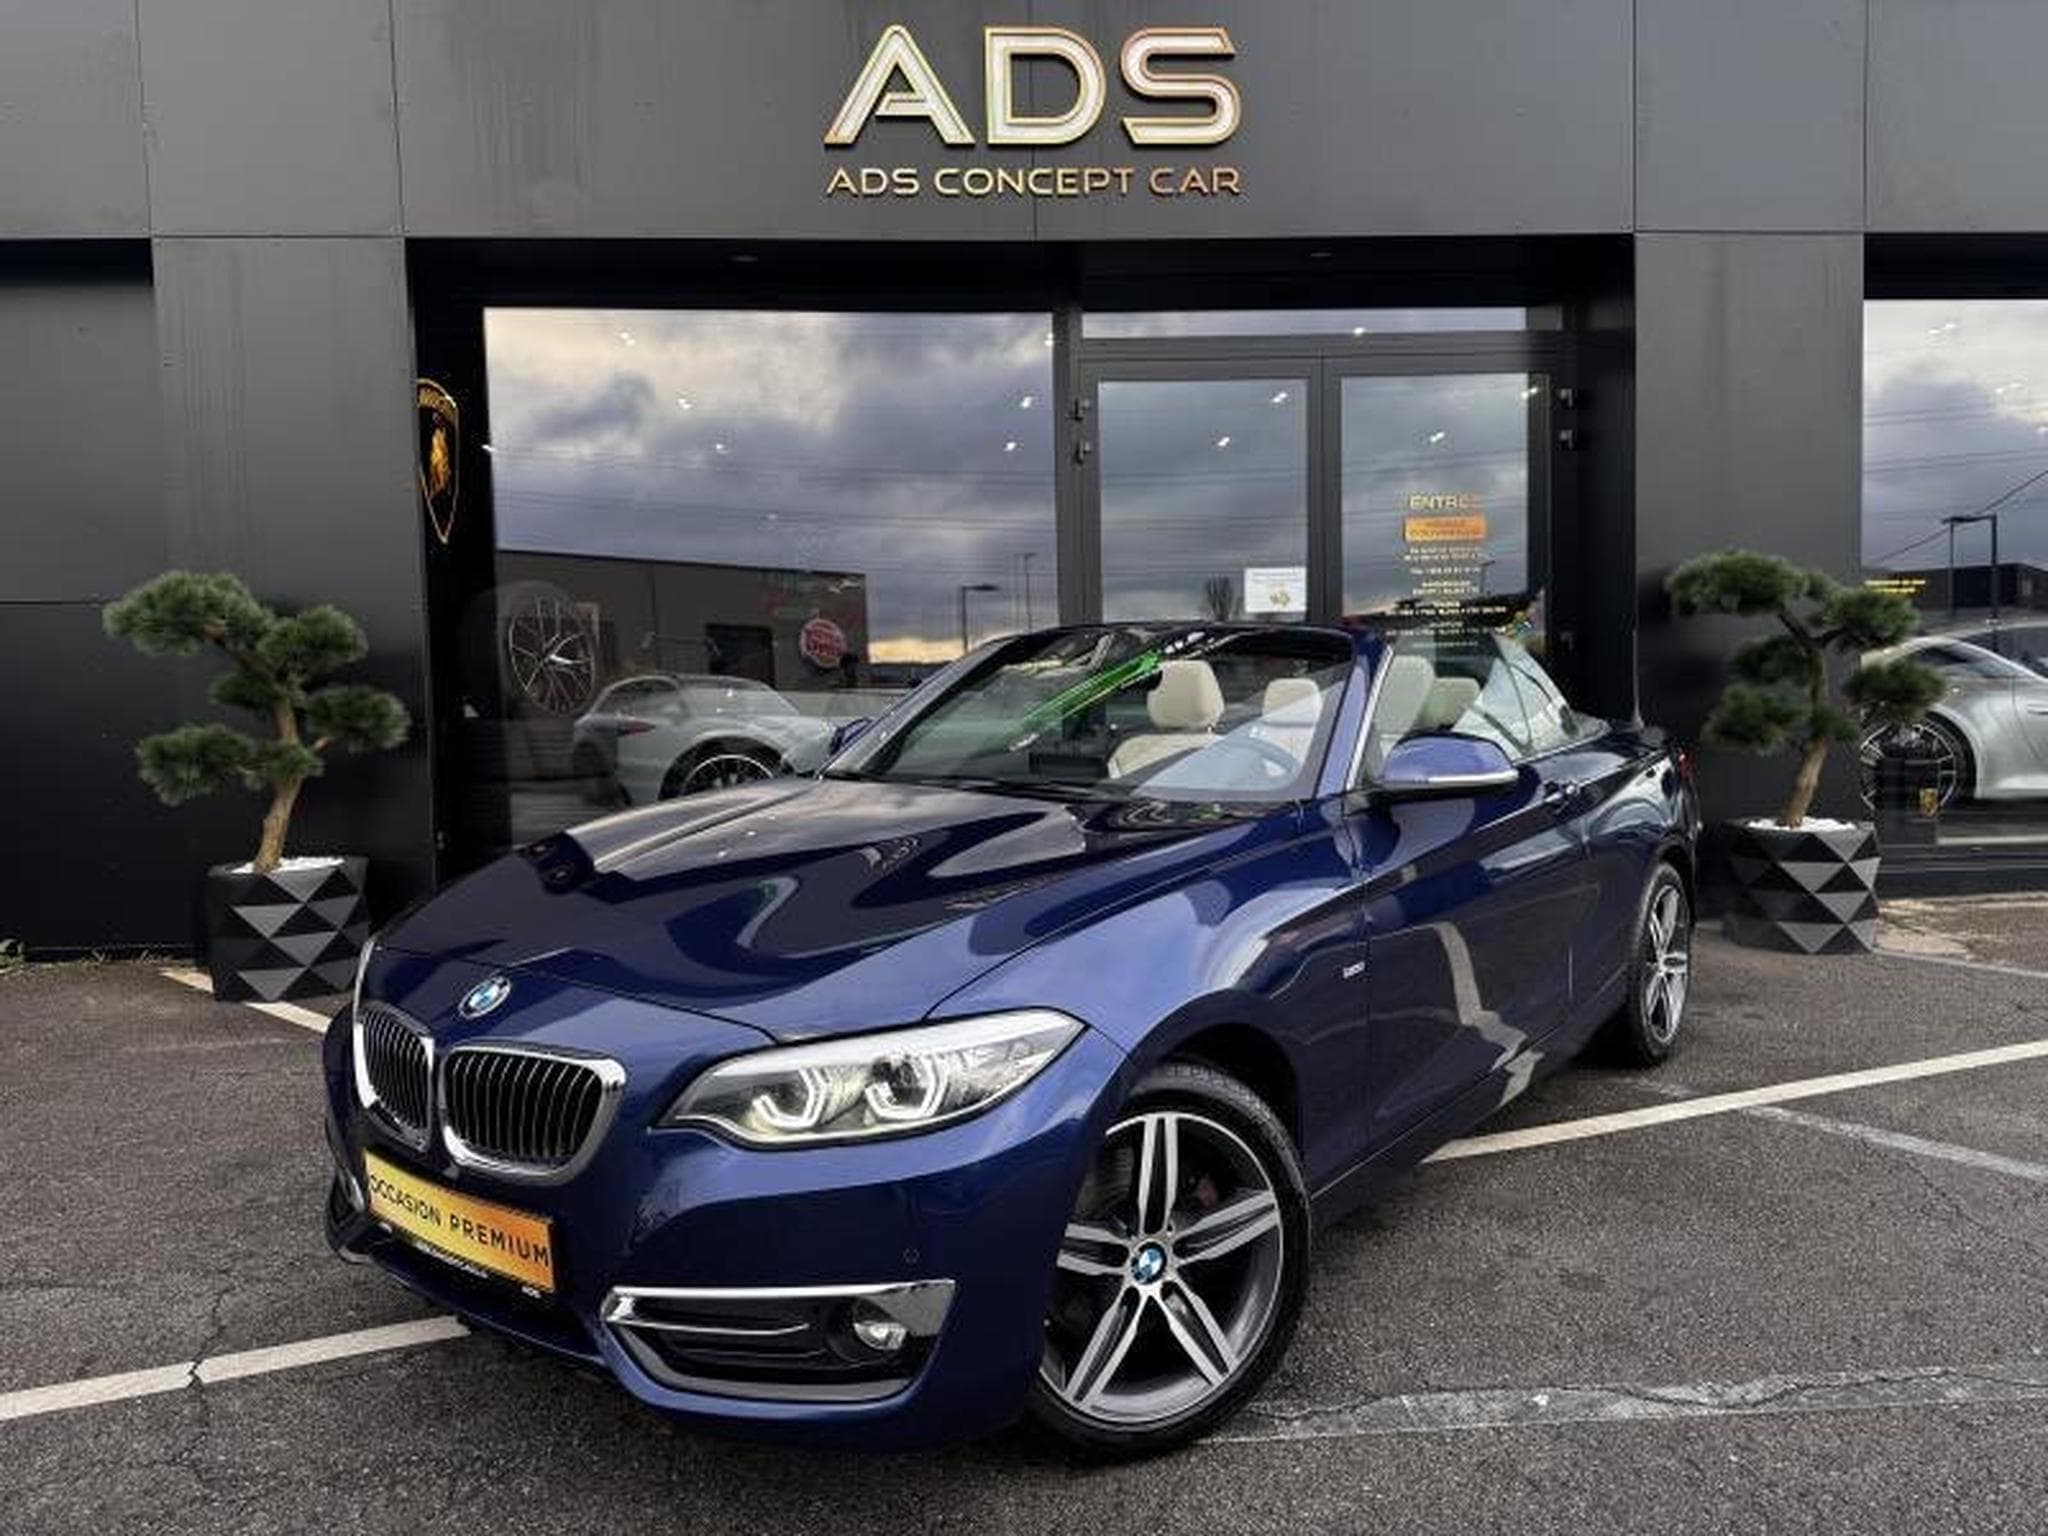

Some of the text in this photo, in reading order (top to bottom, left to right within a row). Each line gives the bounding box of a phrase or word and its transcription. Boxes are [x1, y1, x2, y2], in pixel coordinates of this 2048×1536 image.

[823, 24, 1242, 145] ADS
[826, 167, 1241, 195] ADS CONCEPT CAR
[369, 1174, 442, 1227] OCCASION
[449, 1213, 550, 1268] PREMIUM
